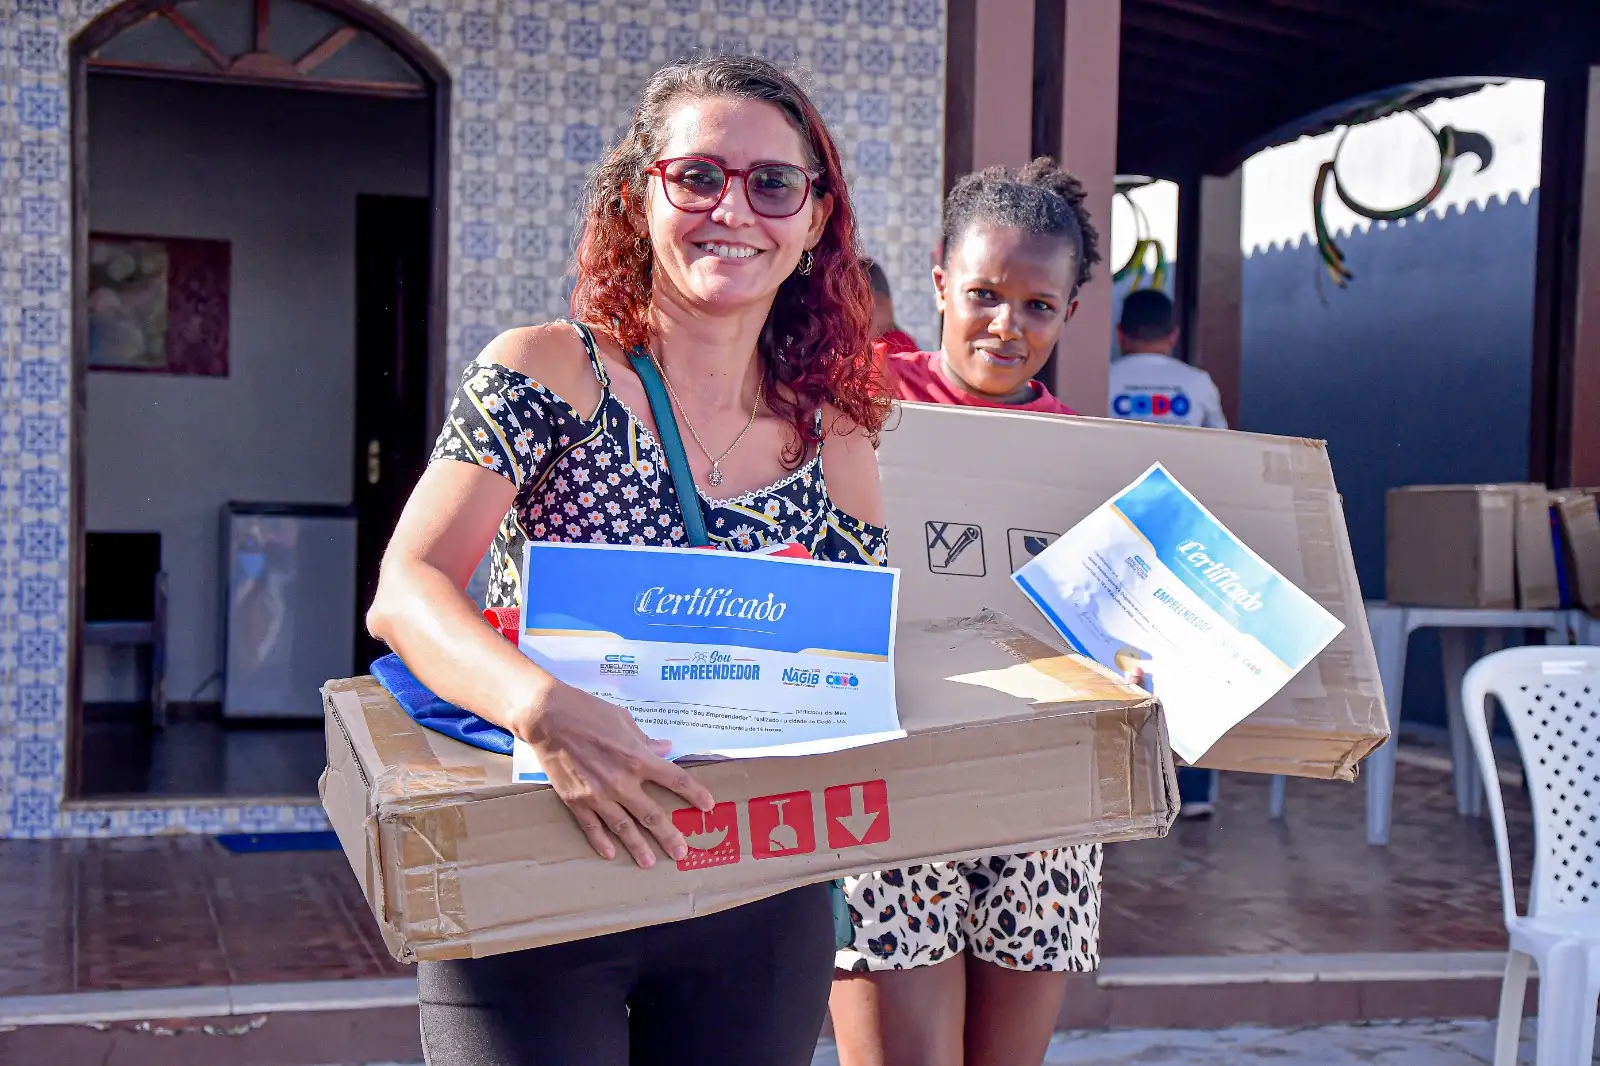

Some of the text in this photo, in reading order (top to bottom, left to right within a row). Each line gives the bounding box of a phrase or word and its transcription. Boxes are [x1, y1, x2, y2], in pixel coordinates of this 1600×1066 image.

[1176, 539, 1263, 611] Certificado
[634, 587, 787, 622] Certificado
[709, 650, 732, 664] Sou
[661, 664, 761, 681] EMPREENDEDOR
[781, 666, 820, 685] NAGIB
